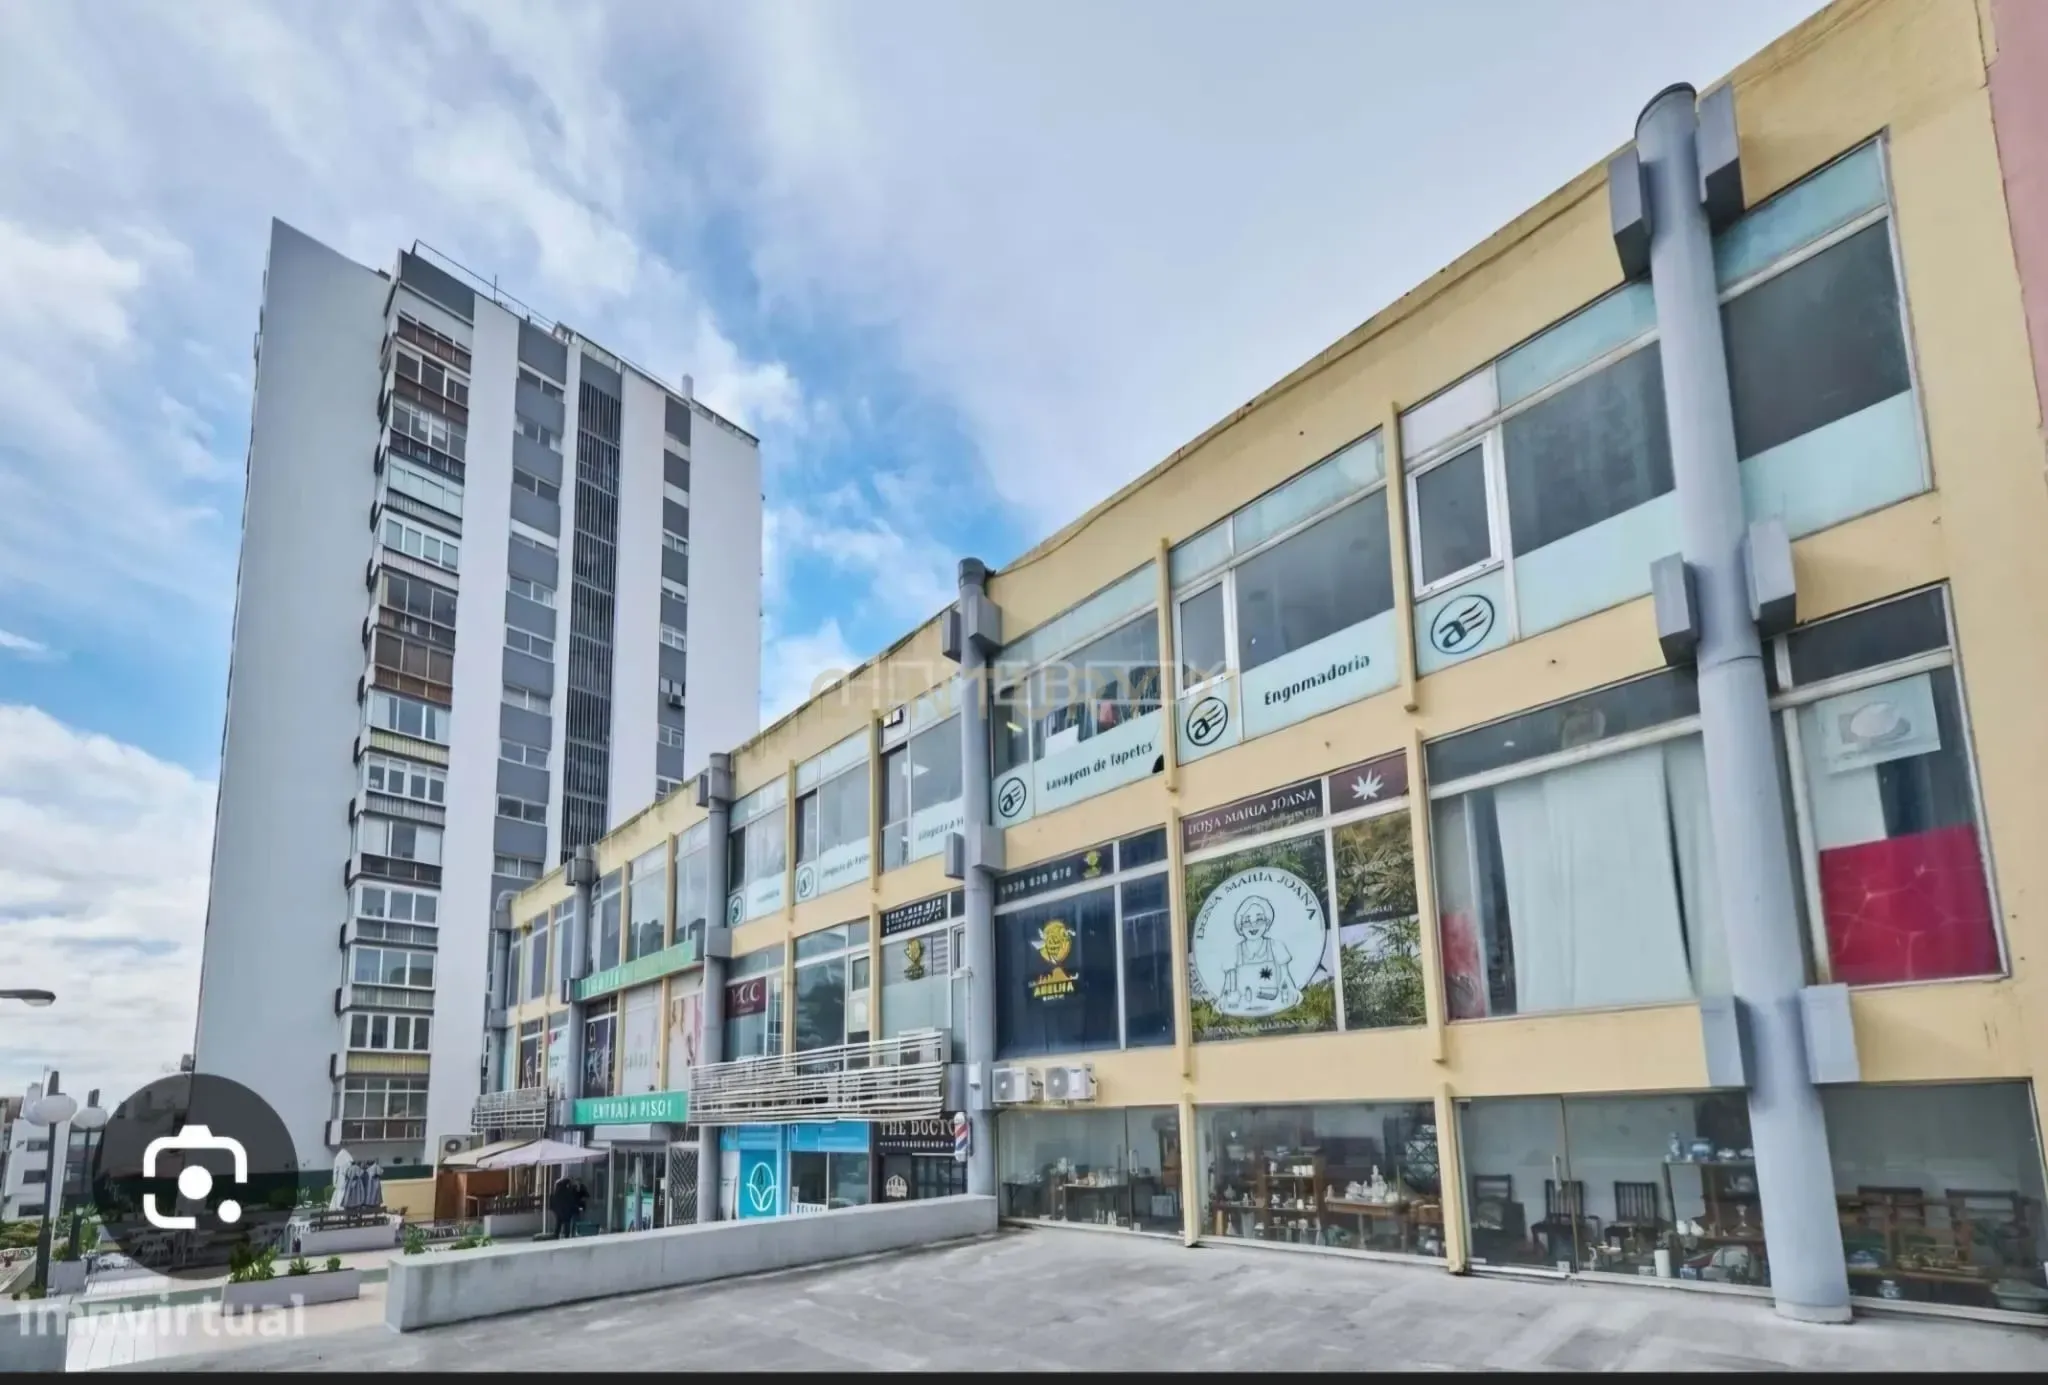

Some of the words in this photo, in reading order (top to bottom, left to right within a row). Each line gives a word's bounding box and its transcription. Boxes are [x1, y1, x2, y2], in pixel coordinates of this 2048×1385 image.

[1264, 655, 1370, 706] Engomadoria
[1093, 758, 1107, 773] de
[1110, 741, 1153, 767] Tapetes
[1224, 804, 1267, 825] MARIA
[1270, 788, 1316, 811] JOANA
[1225, 871, 1273, 894] MARIA
[1277, 871, 1317, 921] JOANA
[881, 1119, 906, 1136] THE
